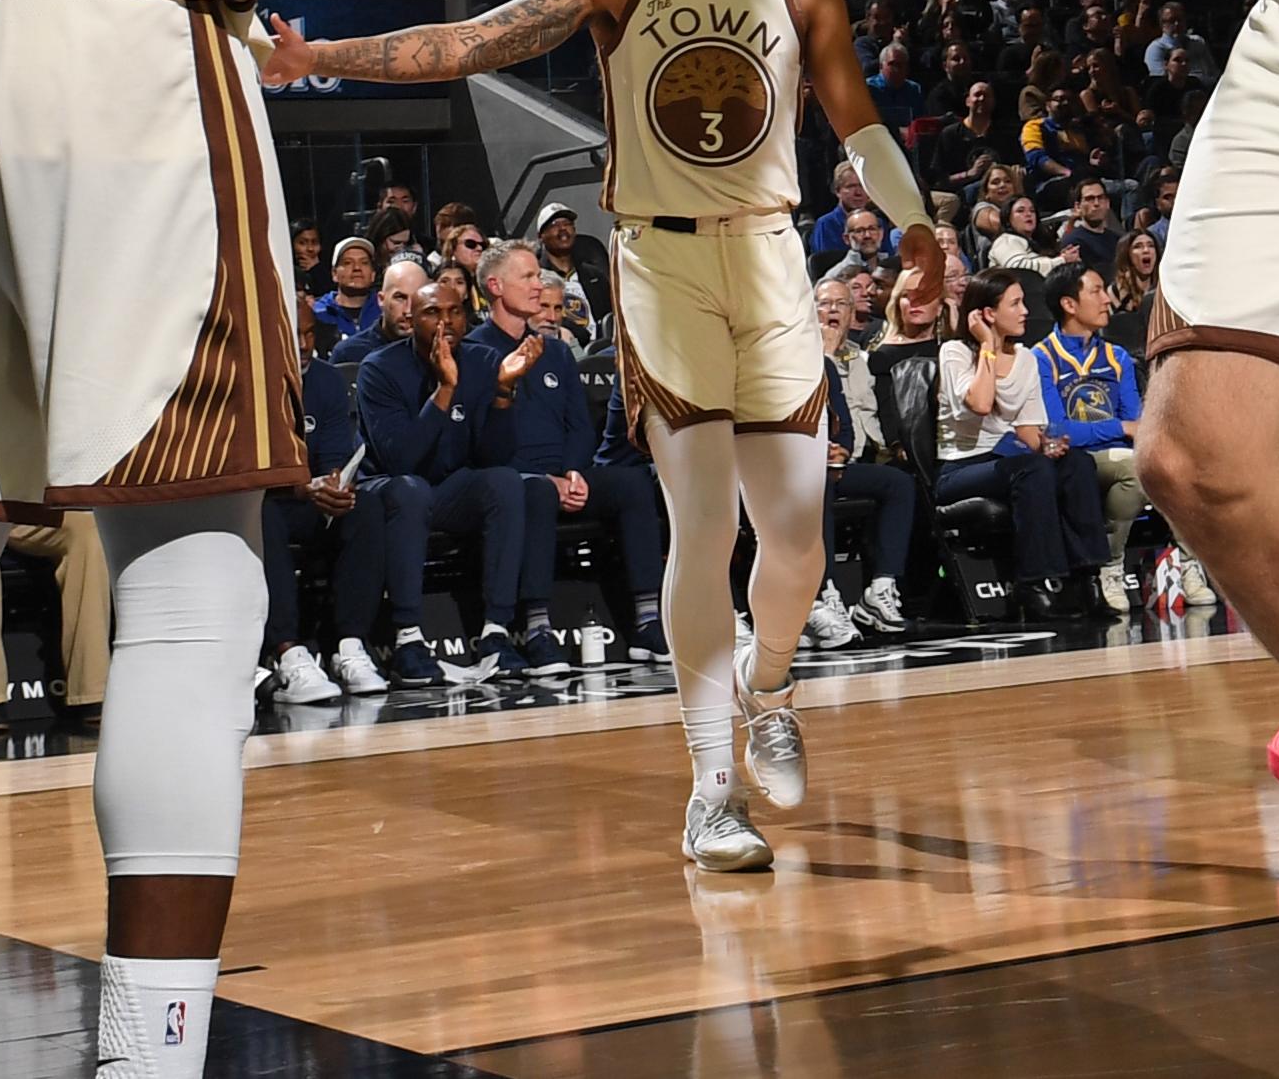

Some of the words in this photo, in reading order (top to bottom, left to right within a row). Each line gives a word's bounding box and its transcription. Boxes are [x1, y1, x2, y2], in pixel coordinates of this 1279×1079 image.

[639, 3, 781, 58] TOWN
[699, 112, 724, 152] 3
[1086, 390, 1105, 407] 30
